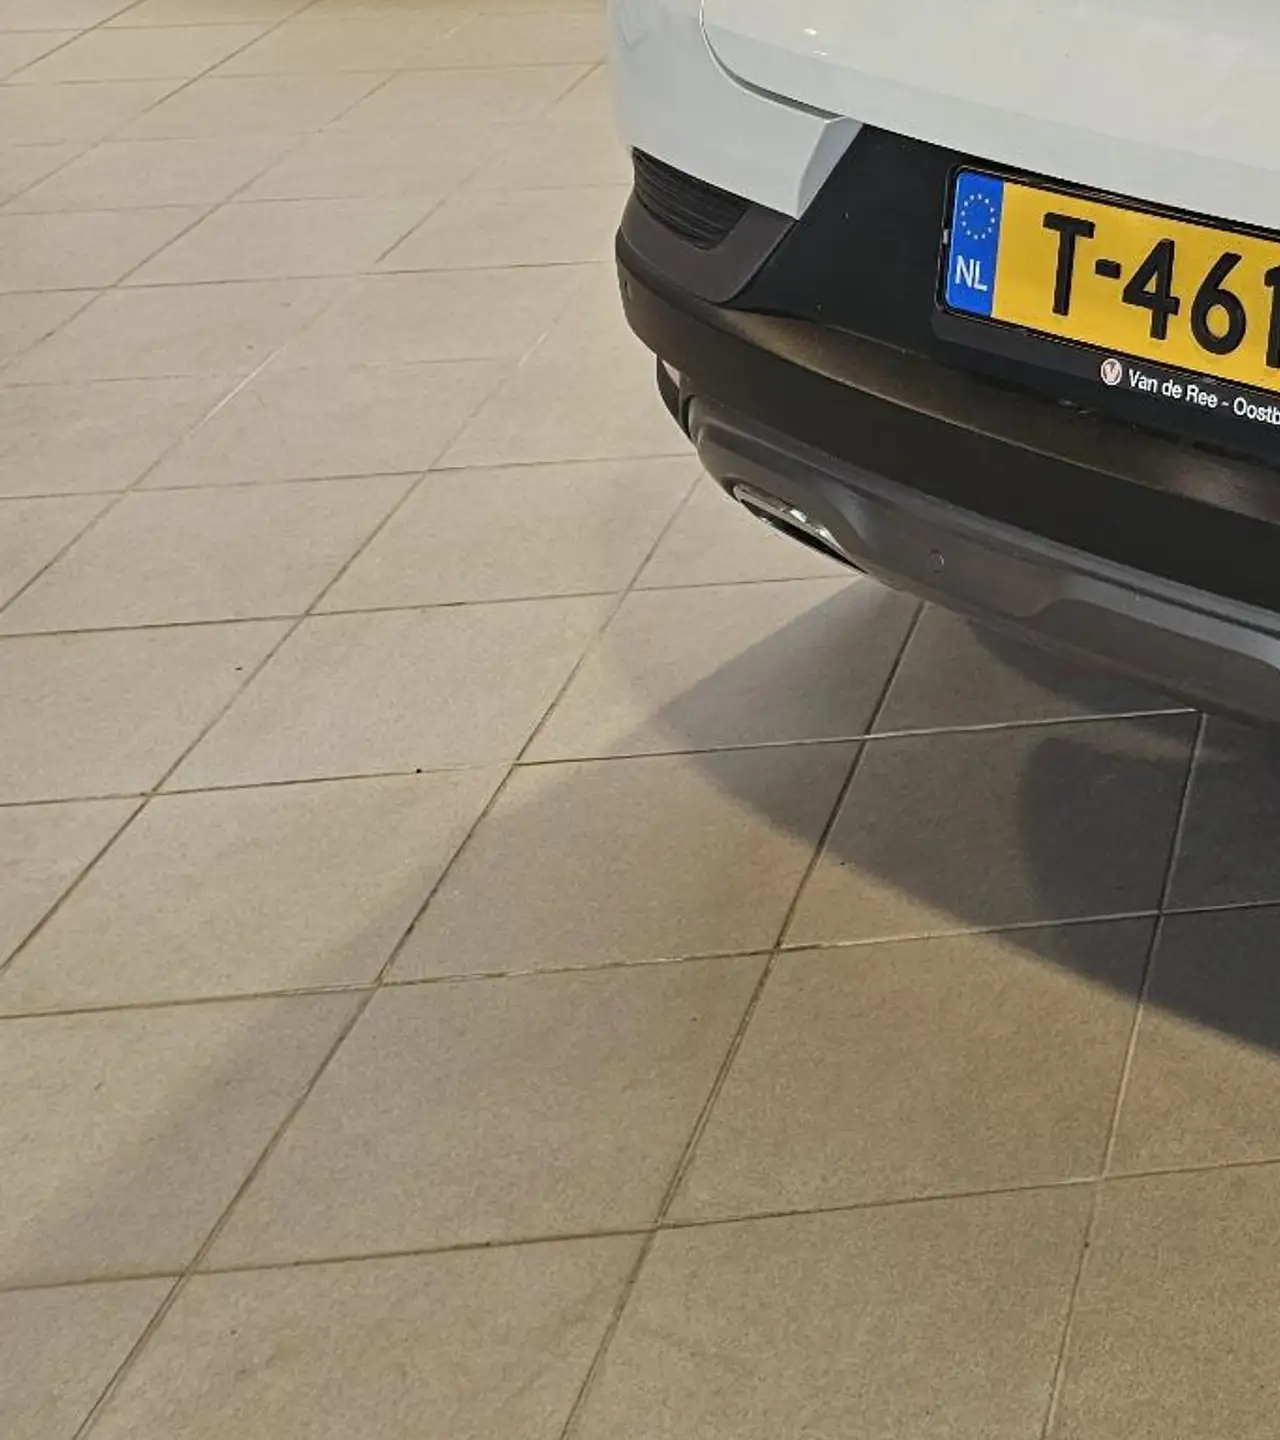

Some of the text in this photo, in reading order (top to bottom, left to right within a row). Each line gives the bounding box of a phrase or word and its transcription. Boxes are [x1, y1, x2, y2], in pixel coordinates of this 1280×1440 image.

[954, 254, 989, 293] NL
[1128, 368, 1158, 393] Van
[1161, 379, 1182, 399] de
[1186, 384, 1218, 409] Ree
